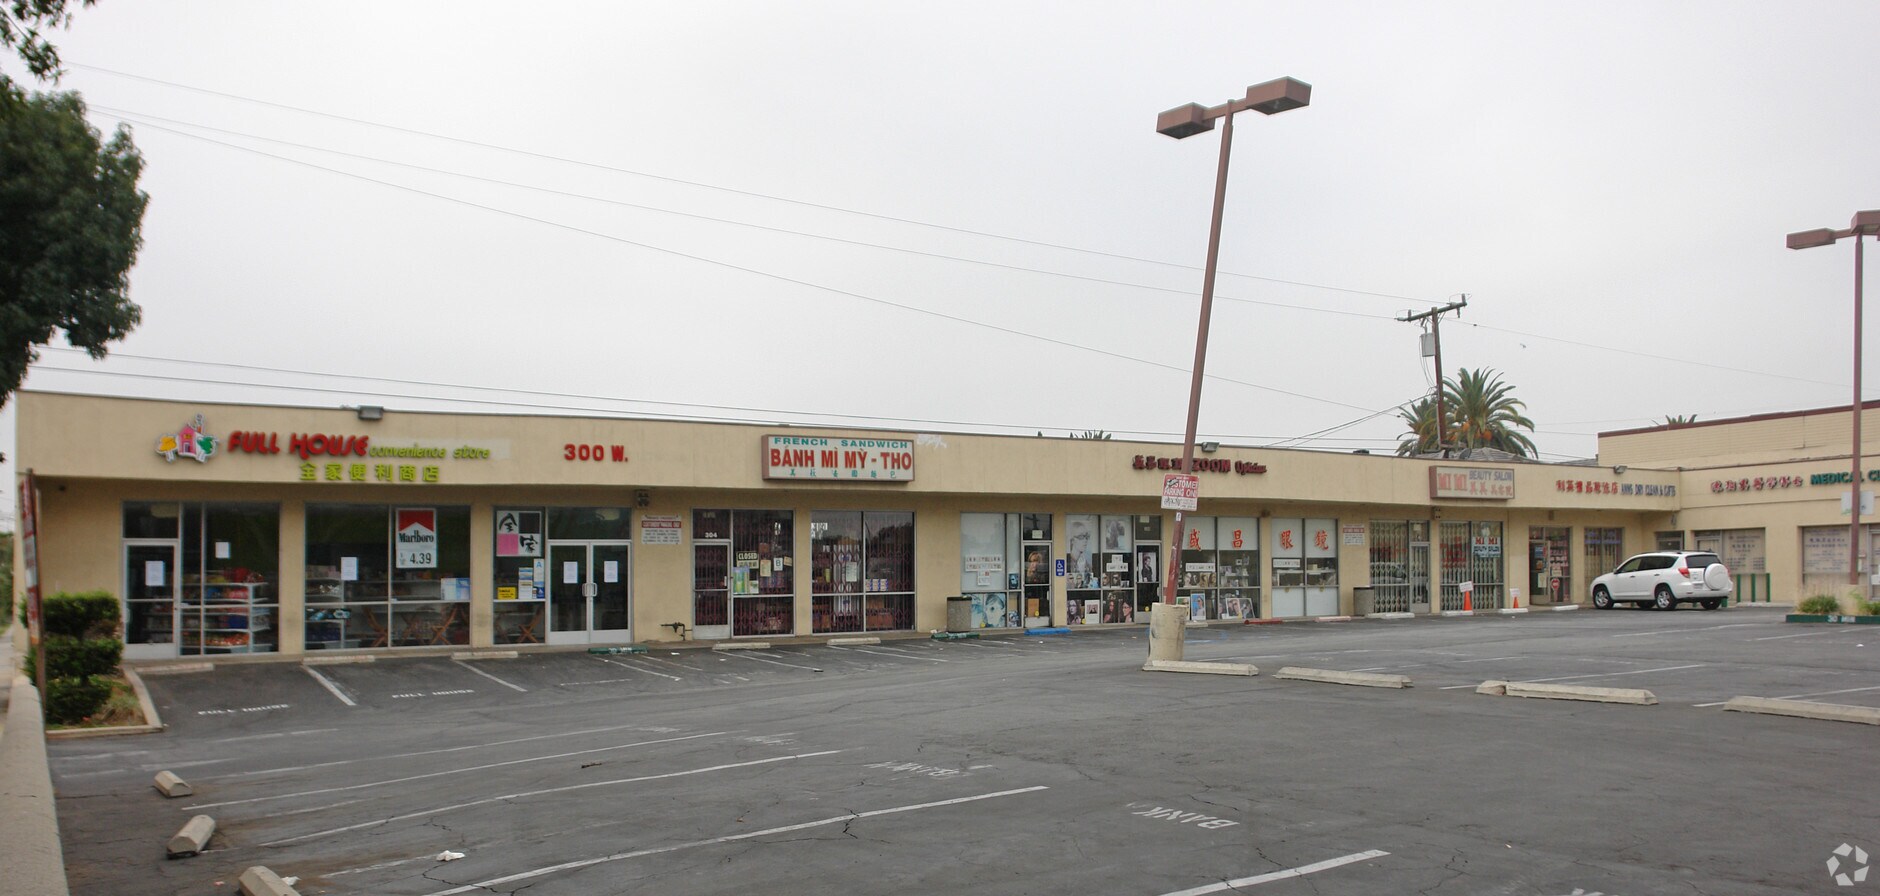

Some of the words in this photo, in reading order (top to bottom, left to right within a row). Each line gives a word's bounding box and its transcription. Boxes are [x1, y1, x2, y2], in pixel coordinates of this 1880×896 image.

[227, 430, 280, 454] FULL
[290, 432, 369, 460] HOUSE
[369, 443, 446, 459] convenience
[453, 444, 490, 460] store
[773, 437, 828, 446] FRENCH
[840, 439, 908, 449] SANDWICH
[564, 443, 605, 461] 300
[611, 445, 628, 462] W.
[880, 451, 912, 470] THO
[299, 462, 440, 482] 全家便利商店
[1191, 457, 1232, 473] ZOOM
[1437, 473, 1452, 490] MI
[1453, 474, 1468, 491] MI
[1469, 470, 1492, 480] BEAUTY
[1494, 471, 1513, 481] SALON
[398, 530, 434, 543] Marlboro
[409, 552, 431, 564] 4.39
[738, 552, 758, 560] CLOSED
